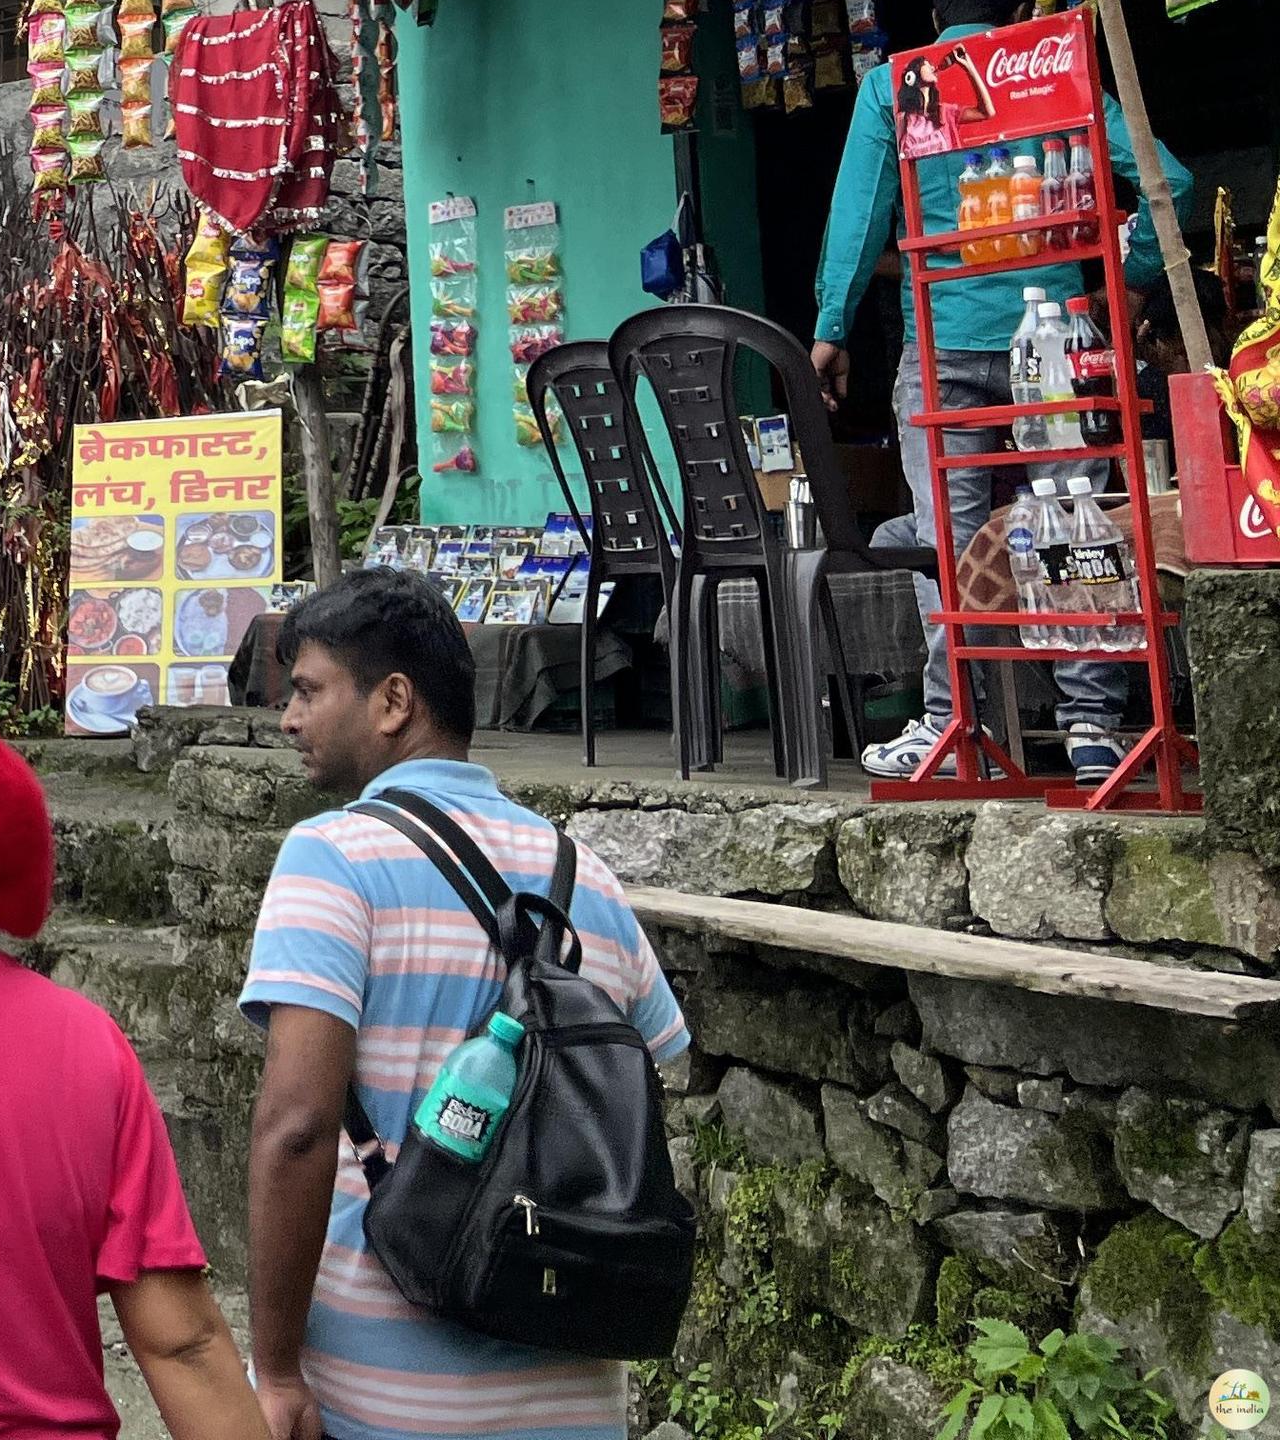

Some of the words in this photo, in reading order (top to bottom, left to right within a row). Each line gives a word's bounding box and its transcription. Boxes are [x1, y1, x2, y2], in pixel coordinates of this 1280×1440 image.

[987, 33, 1074, 87] Coca-Cola
[1010, 87, 1028, 100] Real
[1029, 84, 1054, 98] Magic
[78, 430, 268, 465] ब्रेकफास्ट,
[72, 475, 156, 510] लंच,
[169, 469, 276, 503] डिनर
[440, 1110, 482, 1138] SODA
